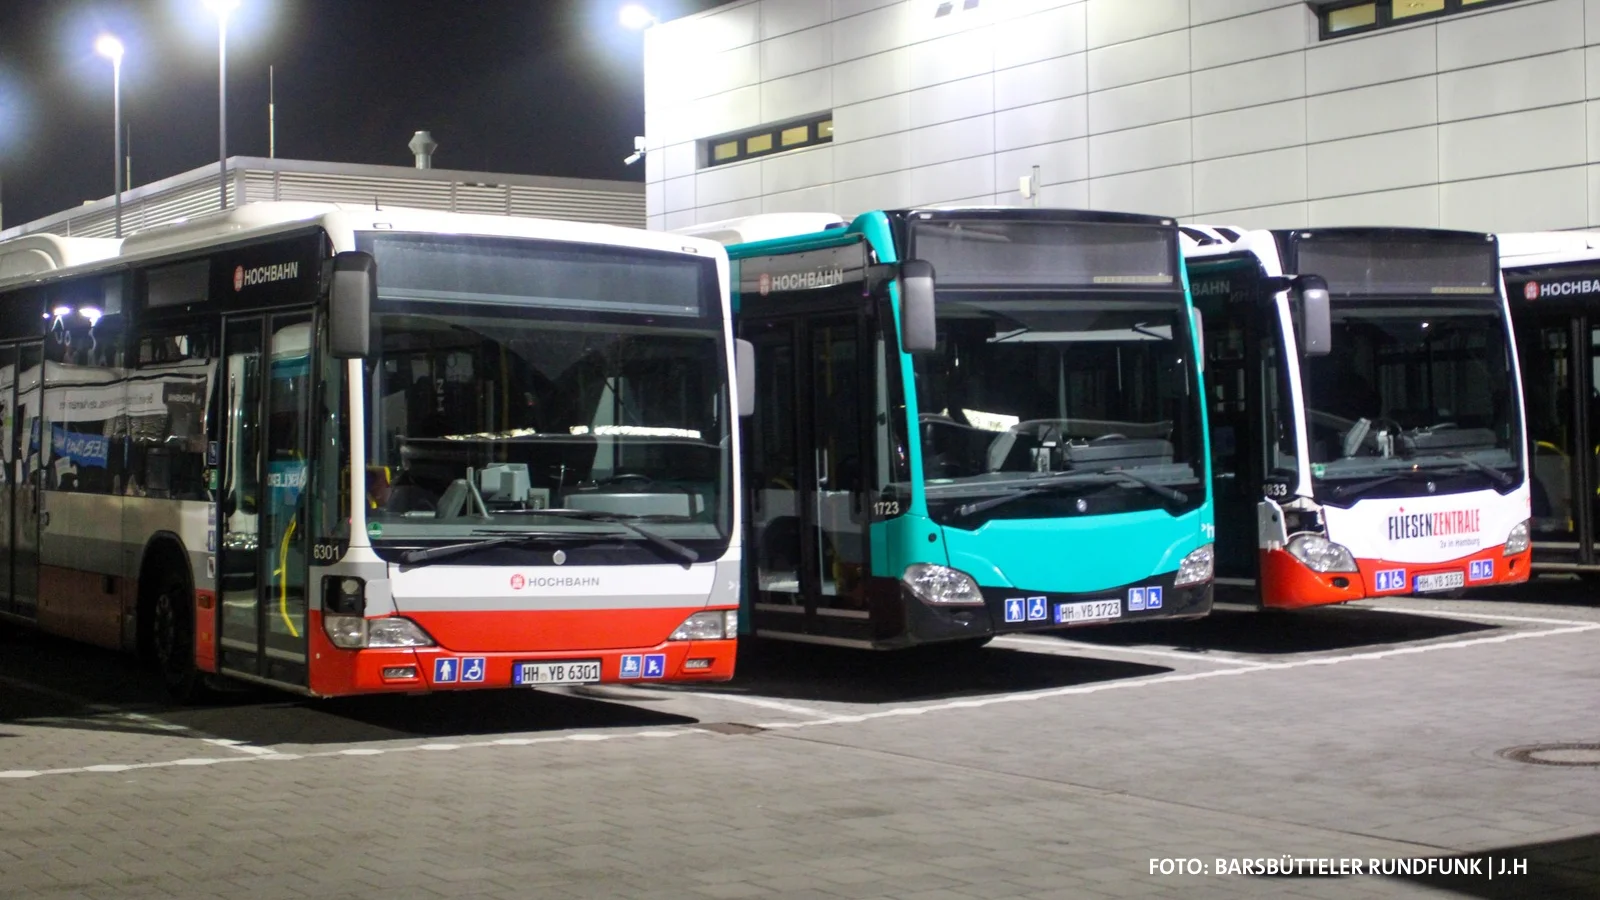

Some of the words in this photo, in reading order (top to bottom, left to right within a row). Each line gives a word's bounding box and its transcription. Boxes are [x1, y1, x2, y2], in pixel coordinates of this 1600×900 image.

[244, 261, 298, 286] HOCHBAHN
[772, 269, 843, 291] HOCHBAHN
[1192, 280, 1230, 296] BAHN
[874, 501, 900, 515] 1723
[1388, 506, 1480, 541] FLIESENZENTRALE
[313, 544, 340, 560] 6301
[1455, 538, 1481, 549] Hamburg
[528, 577, 600, 587] HOCHBAHN
[1061, 606, 1075, 620] HH
[1081, 604, 1094, 618] YB
[1095, 602, 1119, 617] 1723
[522, 666, 540, 682] HH
[548, 665, 565, 681] YB
[567, 664, 599, 680] 6301
